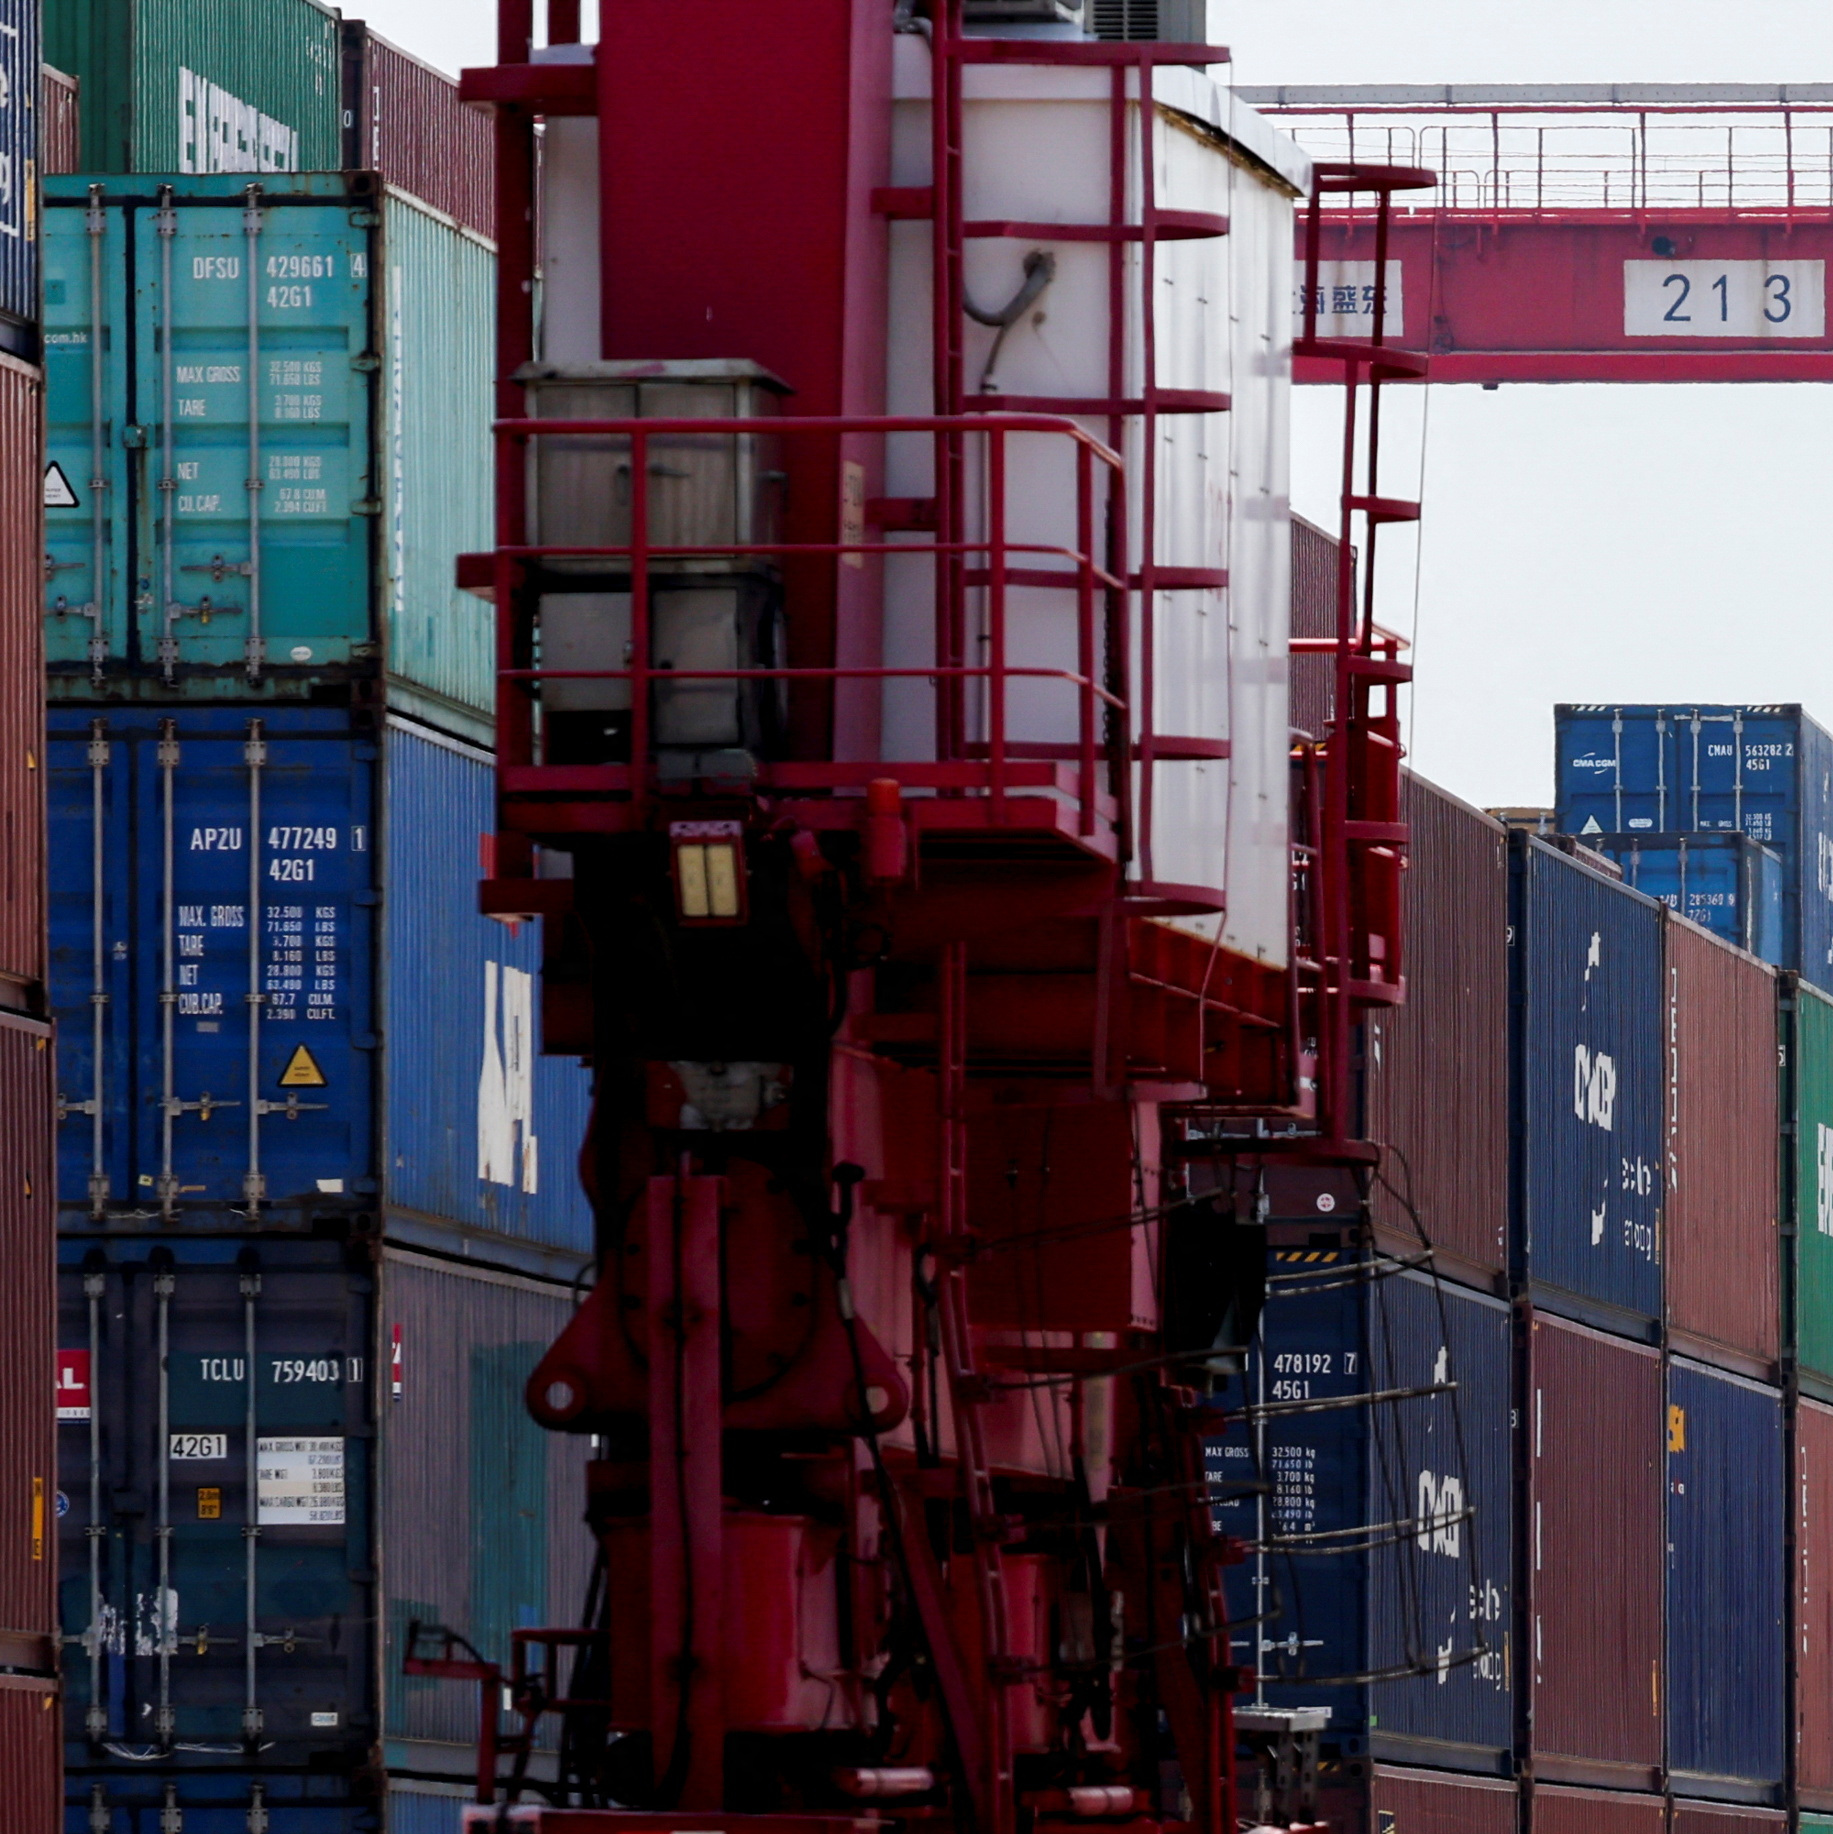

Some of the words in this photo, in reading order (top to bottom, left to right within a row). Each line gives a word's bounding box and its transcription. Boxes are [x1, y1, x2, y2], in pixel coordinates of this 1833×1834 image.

[193, 256, 240, 279] DFSU
[266, 255, 333, 278] 429661
[352, 254, 367, 278] 4
[267, 285, 312, 307] 42G1
[1661, 273, 1793, 324] 213
[176, 366, 203, 383] MAX
[206, 366, 241, 383] GROSS
[178, 399, 206, 416] TARE
[177, 462, 199, 480] NET
[1708, 745, 1733, 757] CMAU
[1745, 744, 1782, 757] 563282
[1572, 759, 1595, 768] CMA
[1595, 759, 1616, 768] CGM
[1745, 759, 1770, 770] 45G1
[190, 828, 242, 850] APZU
[268, 827, 337, 850] 477249
[352, 826, 365, 850] 1
[269, 858, 314, 881] 42G1
[210, 906, 245, 927] GROSS
[315, 906, 336, 918] KGS
[315, 921, 336, 933] LBS
[178, 935, 204, 956] TARE
[315, 935, 336, 947] KGS
[315, 950, 336, 962] LBS
[179, 964, 199, 985] NET
[315, 965, 336, 977] KGS
[315, 979, 336, 991] LBS
[200, 1358, 244, 1381] TCLU
[271, 1360, 339, 1383] 759403
[348, 1358, 361, 1381] 1
[1274, 1354, 1332, 1373] 478192
[1345, 1353, 1356, 1373] 7
[1272, 1380, 1310, 1399] 45G1
[172, 1436, 222, 1457] 42G1
[1205, 1447, 1223, 1458] MAX
[1225, 1447, 1249, 1458] GROSS
